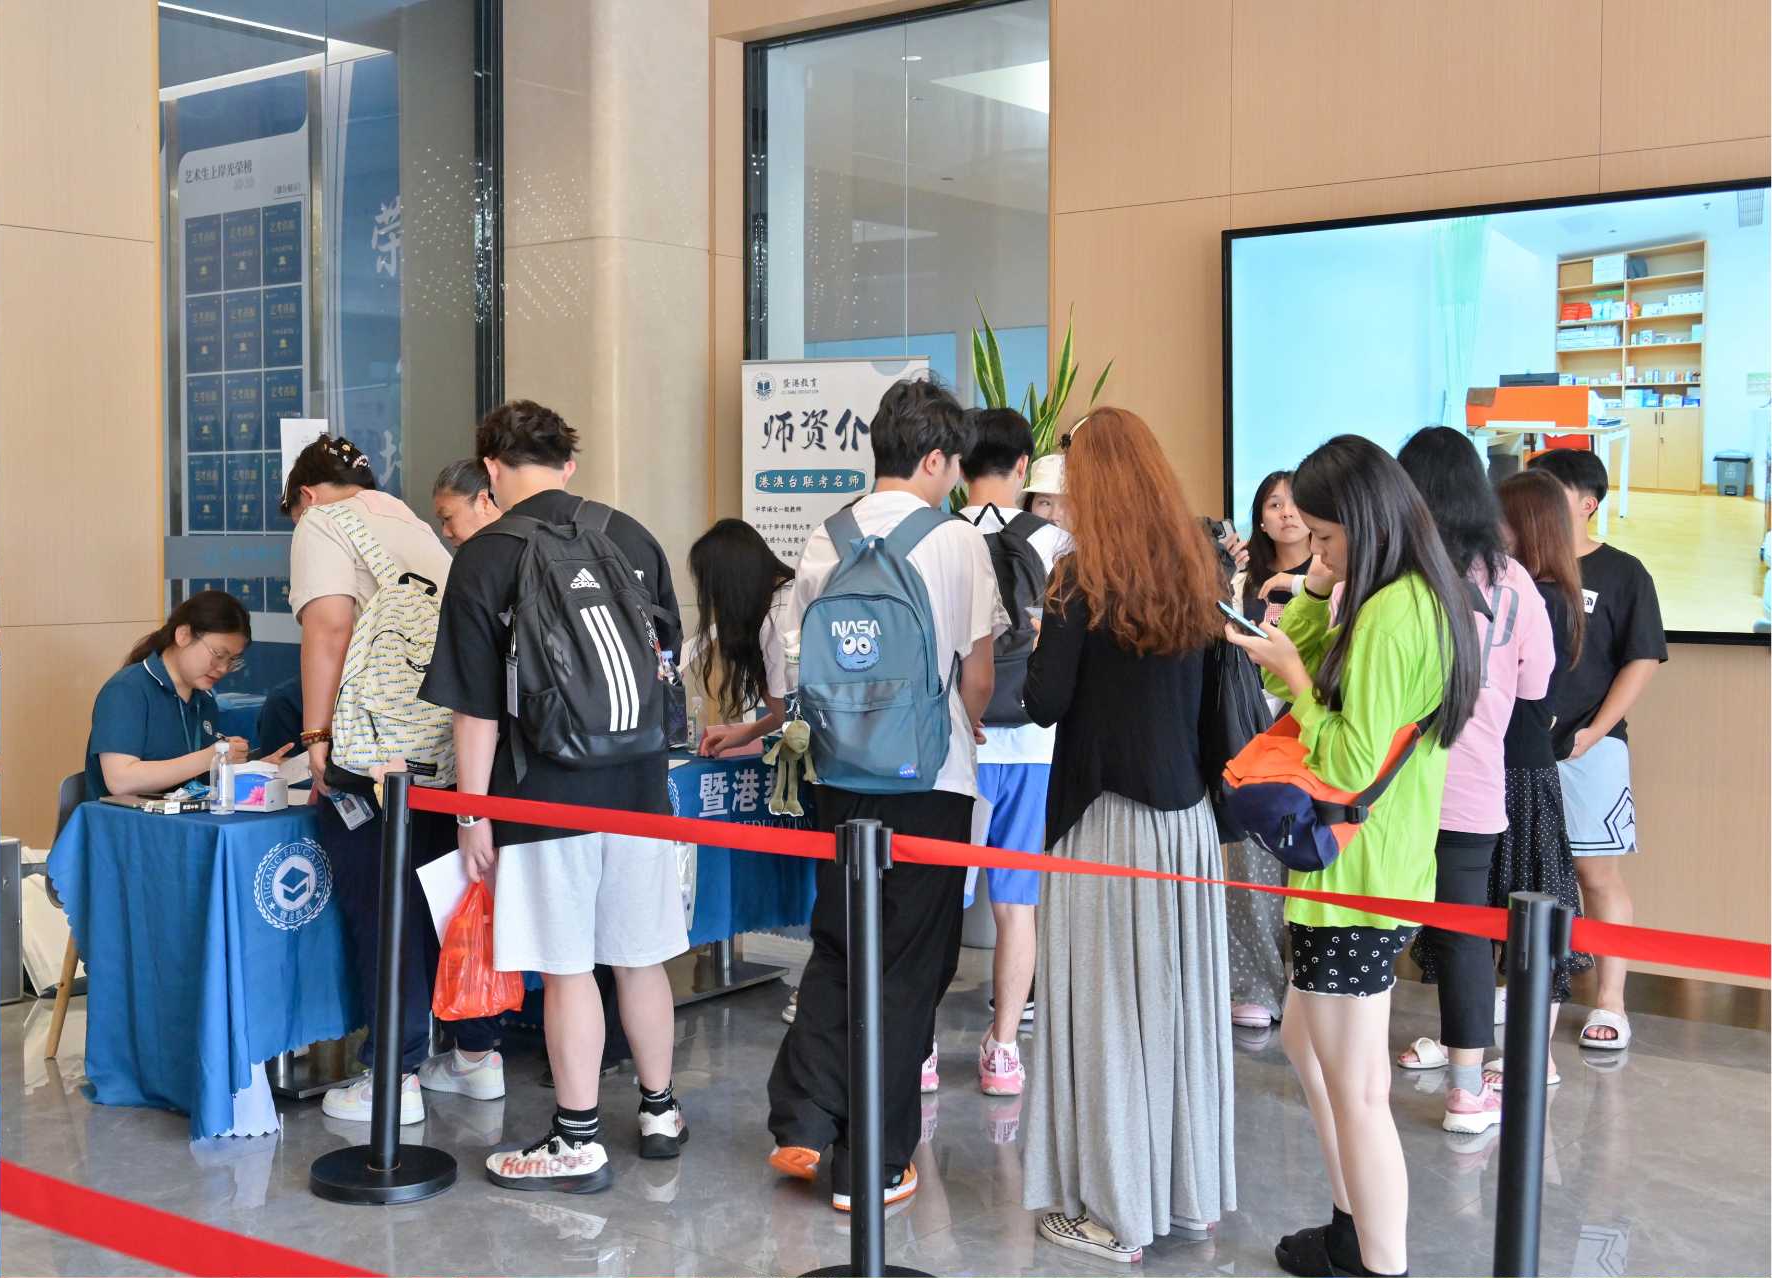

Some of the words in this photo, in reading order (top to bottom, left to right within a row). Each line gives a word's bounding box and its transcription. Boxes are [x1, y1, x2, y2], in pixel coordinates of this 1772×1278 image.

[758, 474, 860, 489] 港澳台联考名师
[570, 581, 601, 590] adidas
[831, 620, 882, 638] NASA
